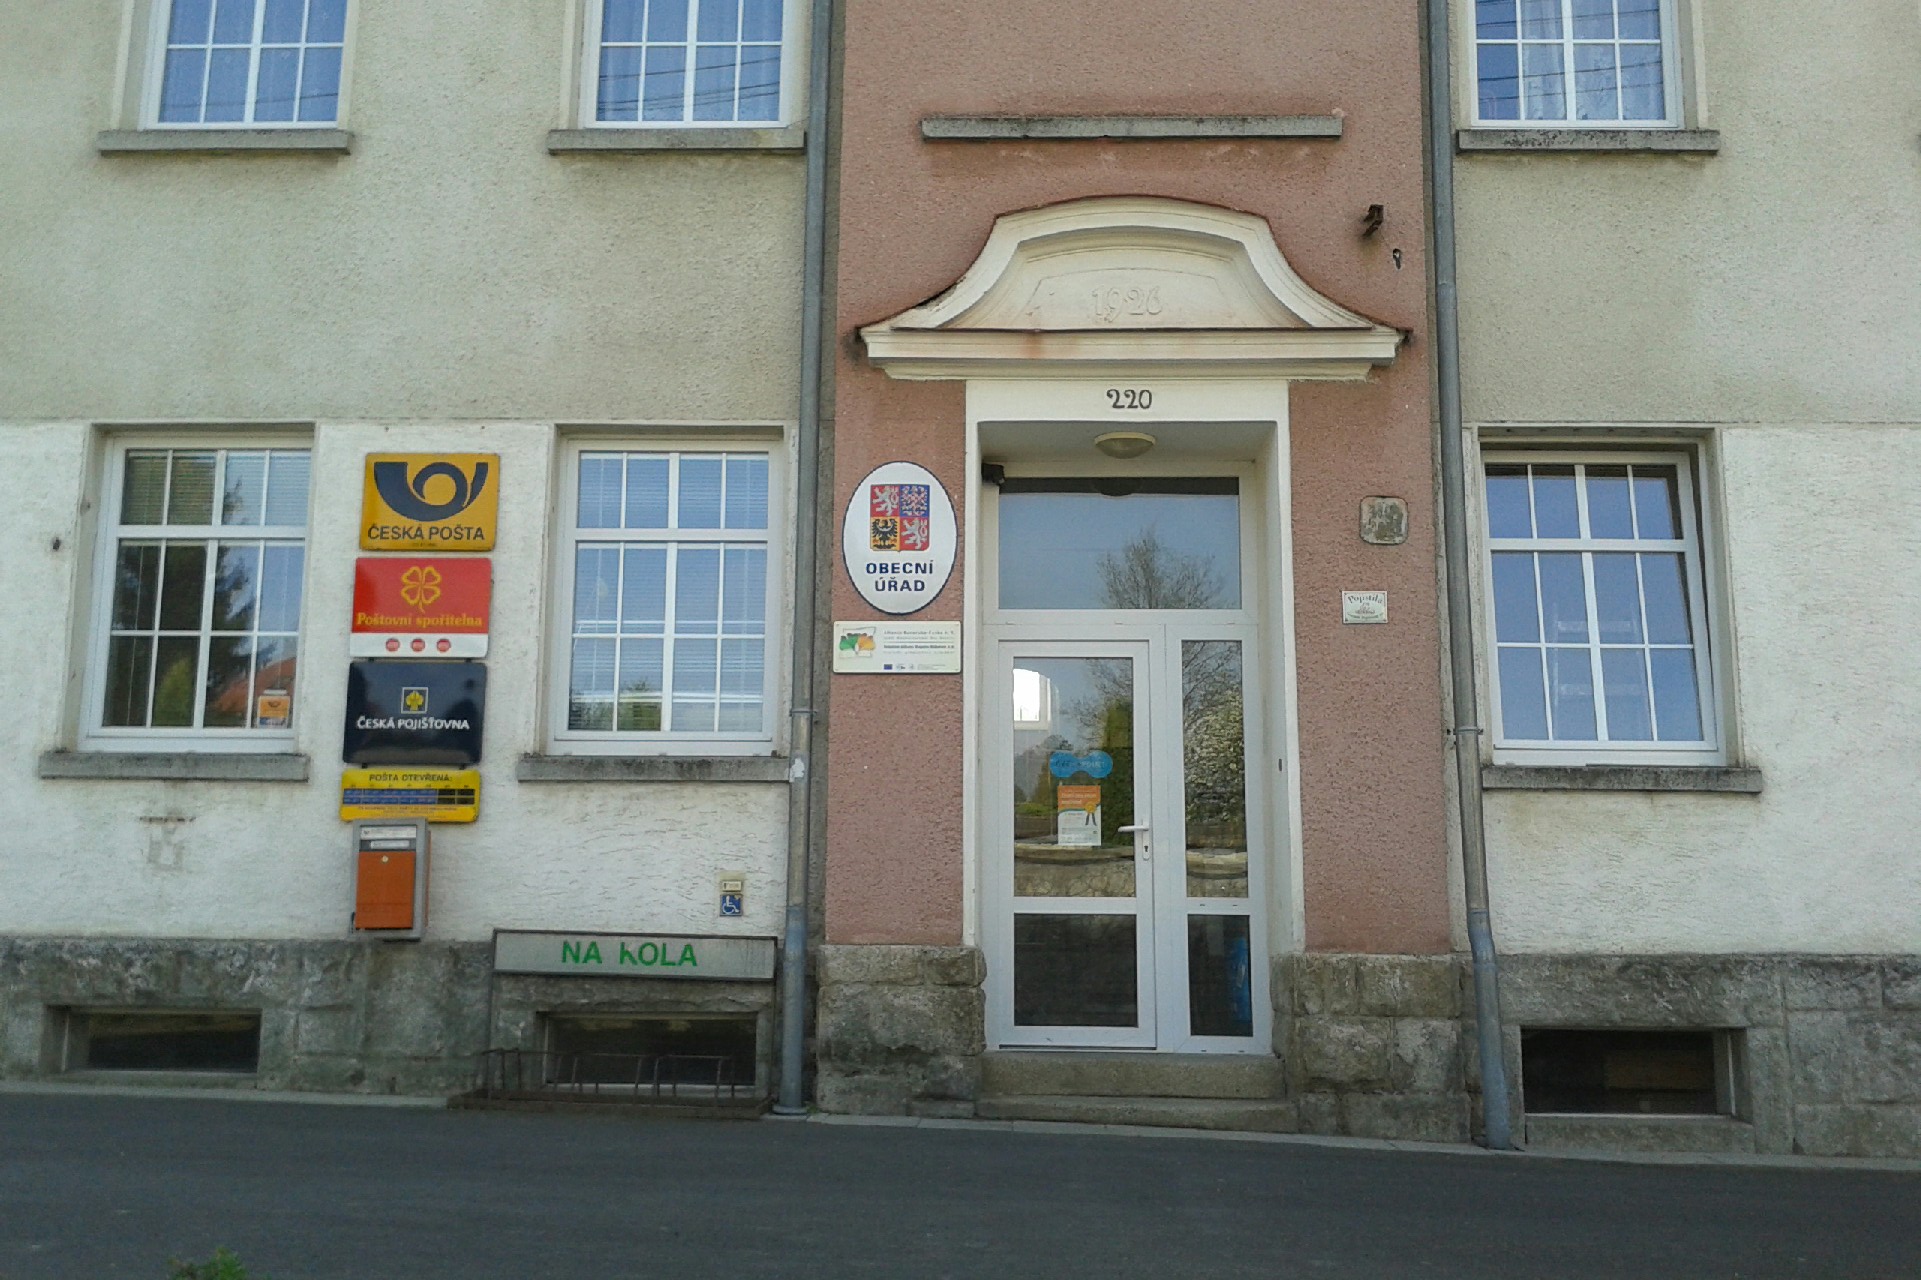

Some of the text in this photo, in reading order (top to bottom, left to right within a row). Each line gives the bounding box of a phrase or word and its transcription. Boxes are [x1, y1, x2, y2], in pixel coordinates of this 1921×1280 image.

[1091, 286, 1162, 322] 1926
[1106, 388, 1152, 409] 220
[367, 523, 485, 541] ČESKÁ POŠTA
[865, 560, 934, 574] OBECNÍ
[875, 576, 925, 592] ÚŘAD
[357, 612, 482, 628] Poštovní spořitelna
[357, 716, 470, 730] ČESKÁ POJIŠŤOVNA
[369, 772, 399, 781] POŠTA
[561, 940, 602, 964] NA
